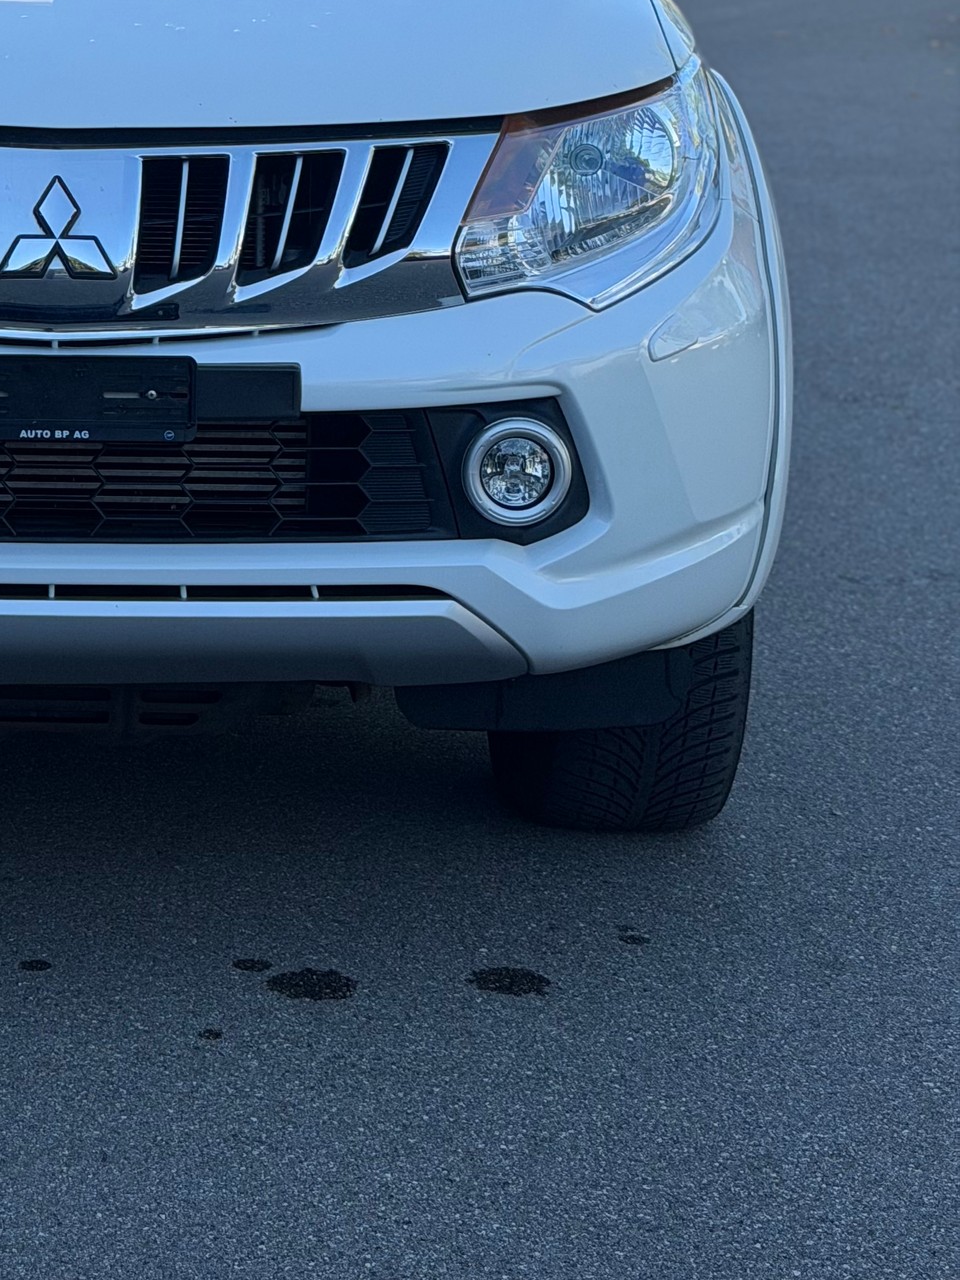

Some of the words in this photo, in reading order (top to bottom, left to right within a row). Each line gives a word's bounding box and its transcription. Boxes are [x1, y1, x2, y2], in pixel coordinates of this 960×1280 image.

[19, 429, 51, 439] AUTO
[54, 429, 70, 439] BP
[73, 430, 90, 439] AG
